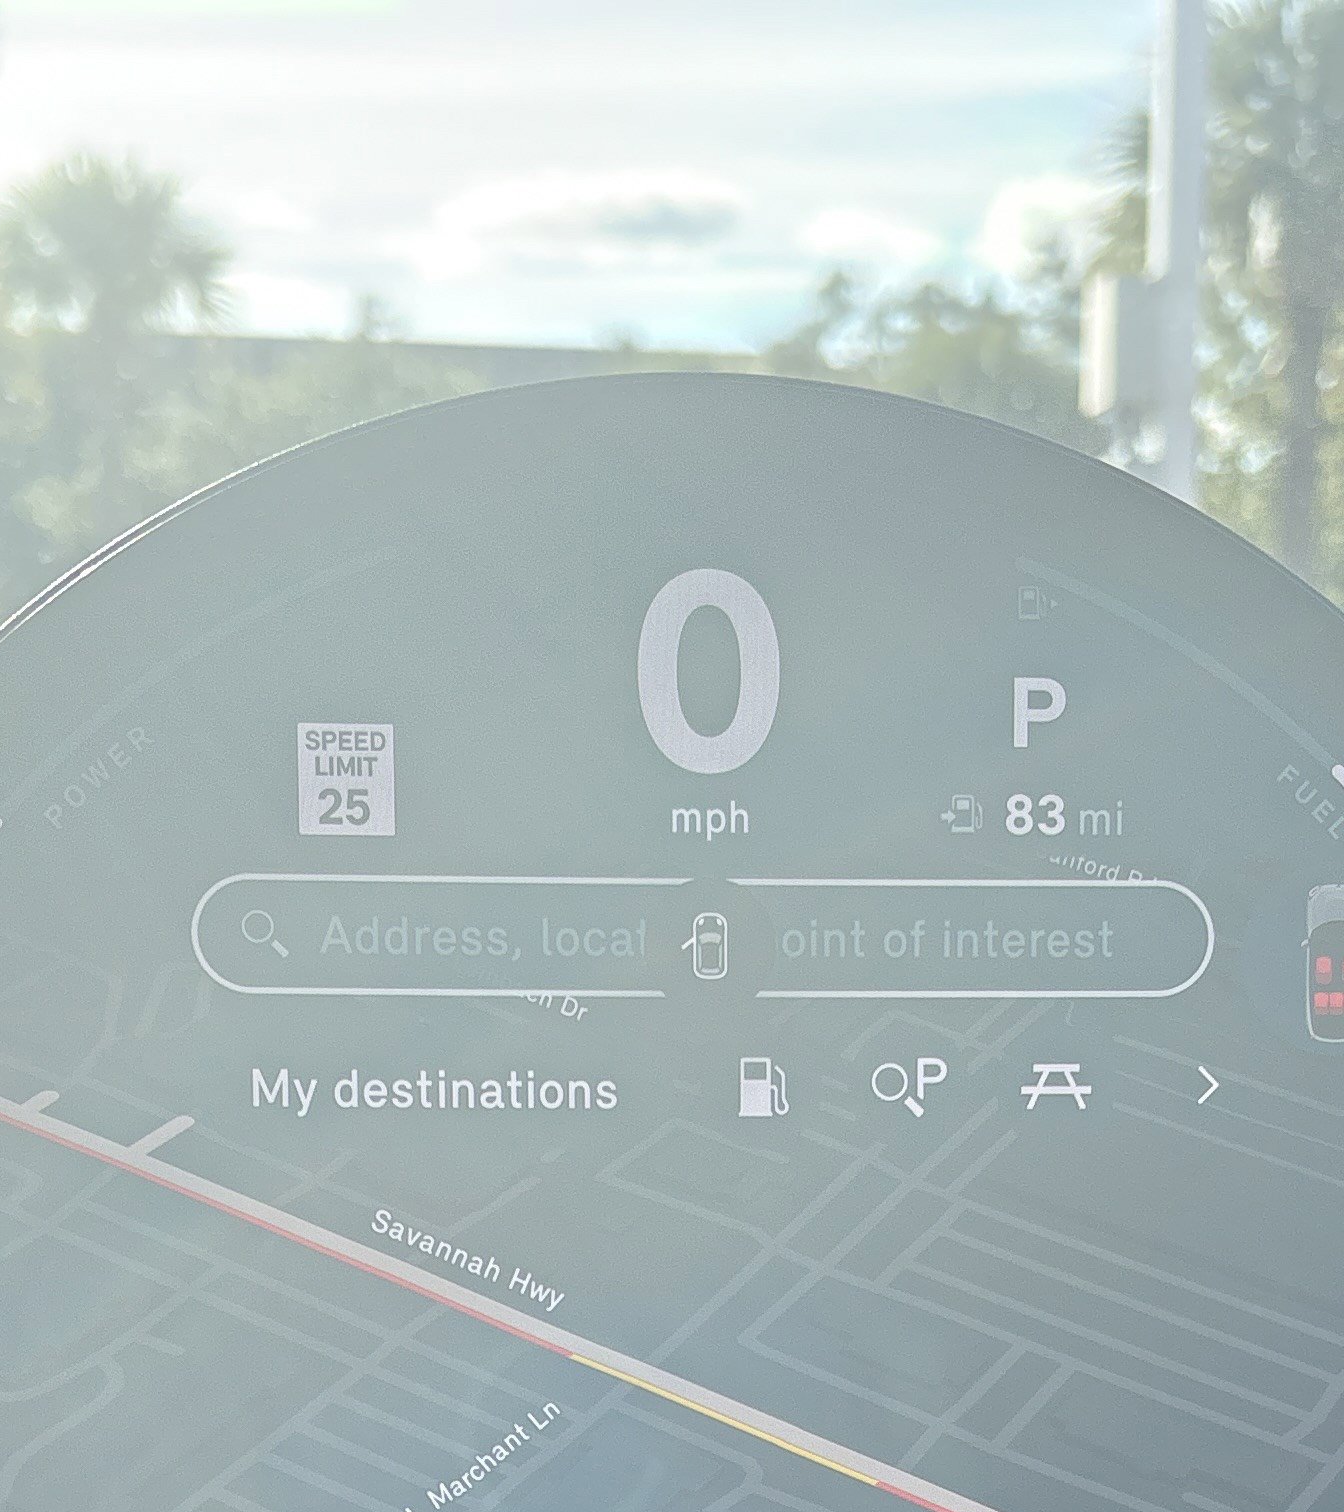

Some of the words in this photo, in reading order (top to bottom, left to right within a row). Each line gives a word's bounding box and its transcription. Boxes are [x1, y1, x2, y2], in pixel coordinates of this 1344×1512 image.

[637, 568, 781, 775] 0
[1013, 677, 1067, 748] P
[305, 730, 386, 752] SPEED
[43, 726, 155, 829] POWER
[314, 756, 378, 777] LIMIT
[317, 789, 371, 825] 25
[670, 801, 751, 840] mph
[1004, 794, 1067, 837] 83
[1078, 801, 1124, 836] mi
[319, 915, 523, 962] Address,
[781, 921, 866, 959] oint
[883, 919, 926, 959] of
[942, 919, 1113, 959] interest
[560, 996, 588, 1021] Dr
[251, 1068, 318, 1118] My
[334, 1070, 618, 1109] destinations
[917, 1057, 948, 1099] P
[371, 1209, 500, 1283] Savannah
[509, 1268, 566, 1313] Hwy
[426, 1422, 530, 1510] Marchant
[526, 1401, 562, 1432] Ln
